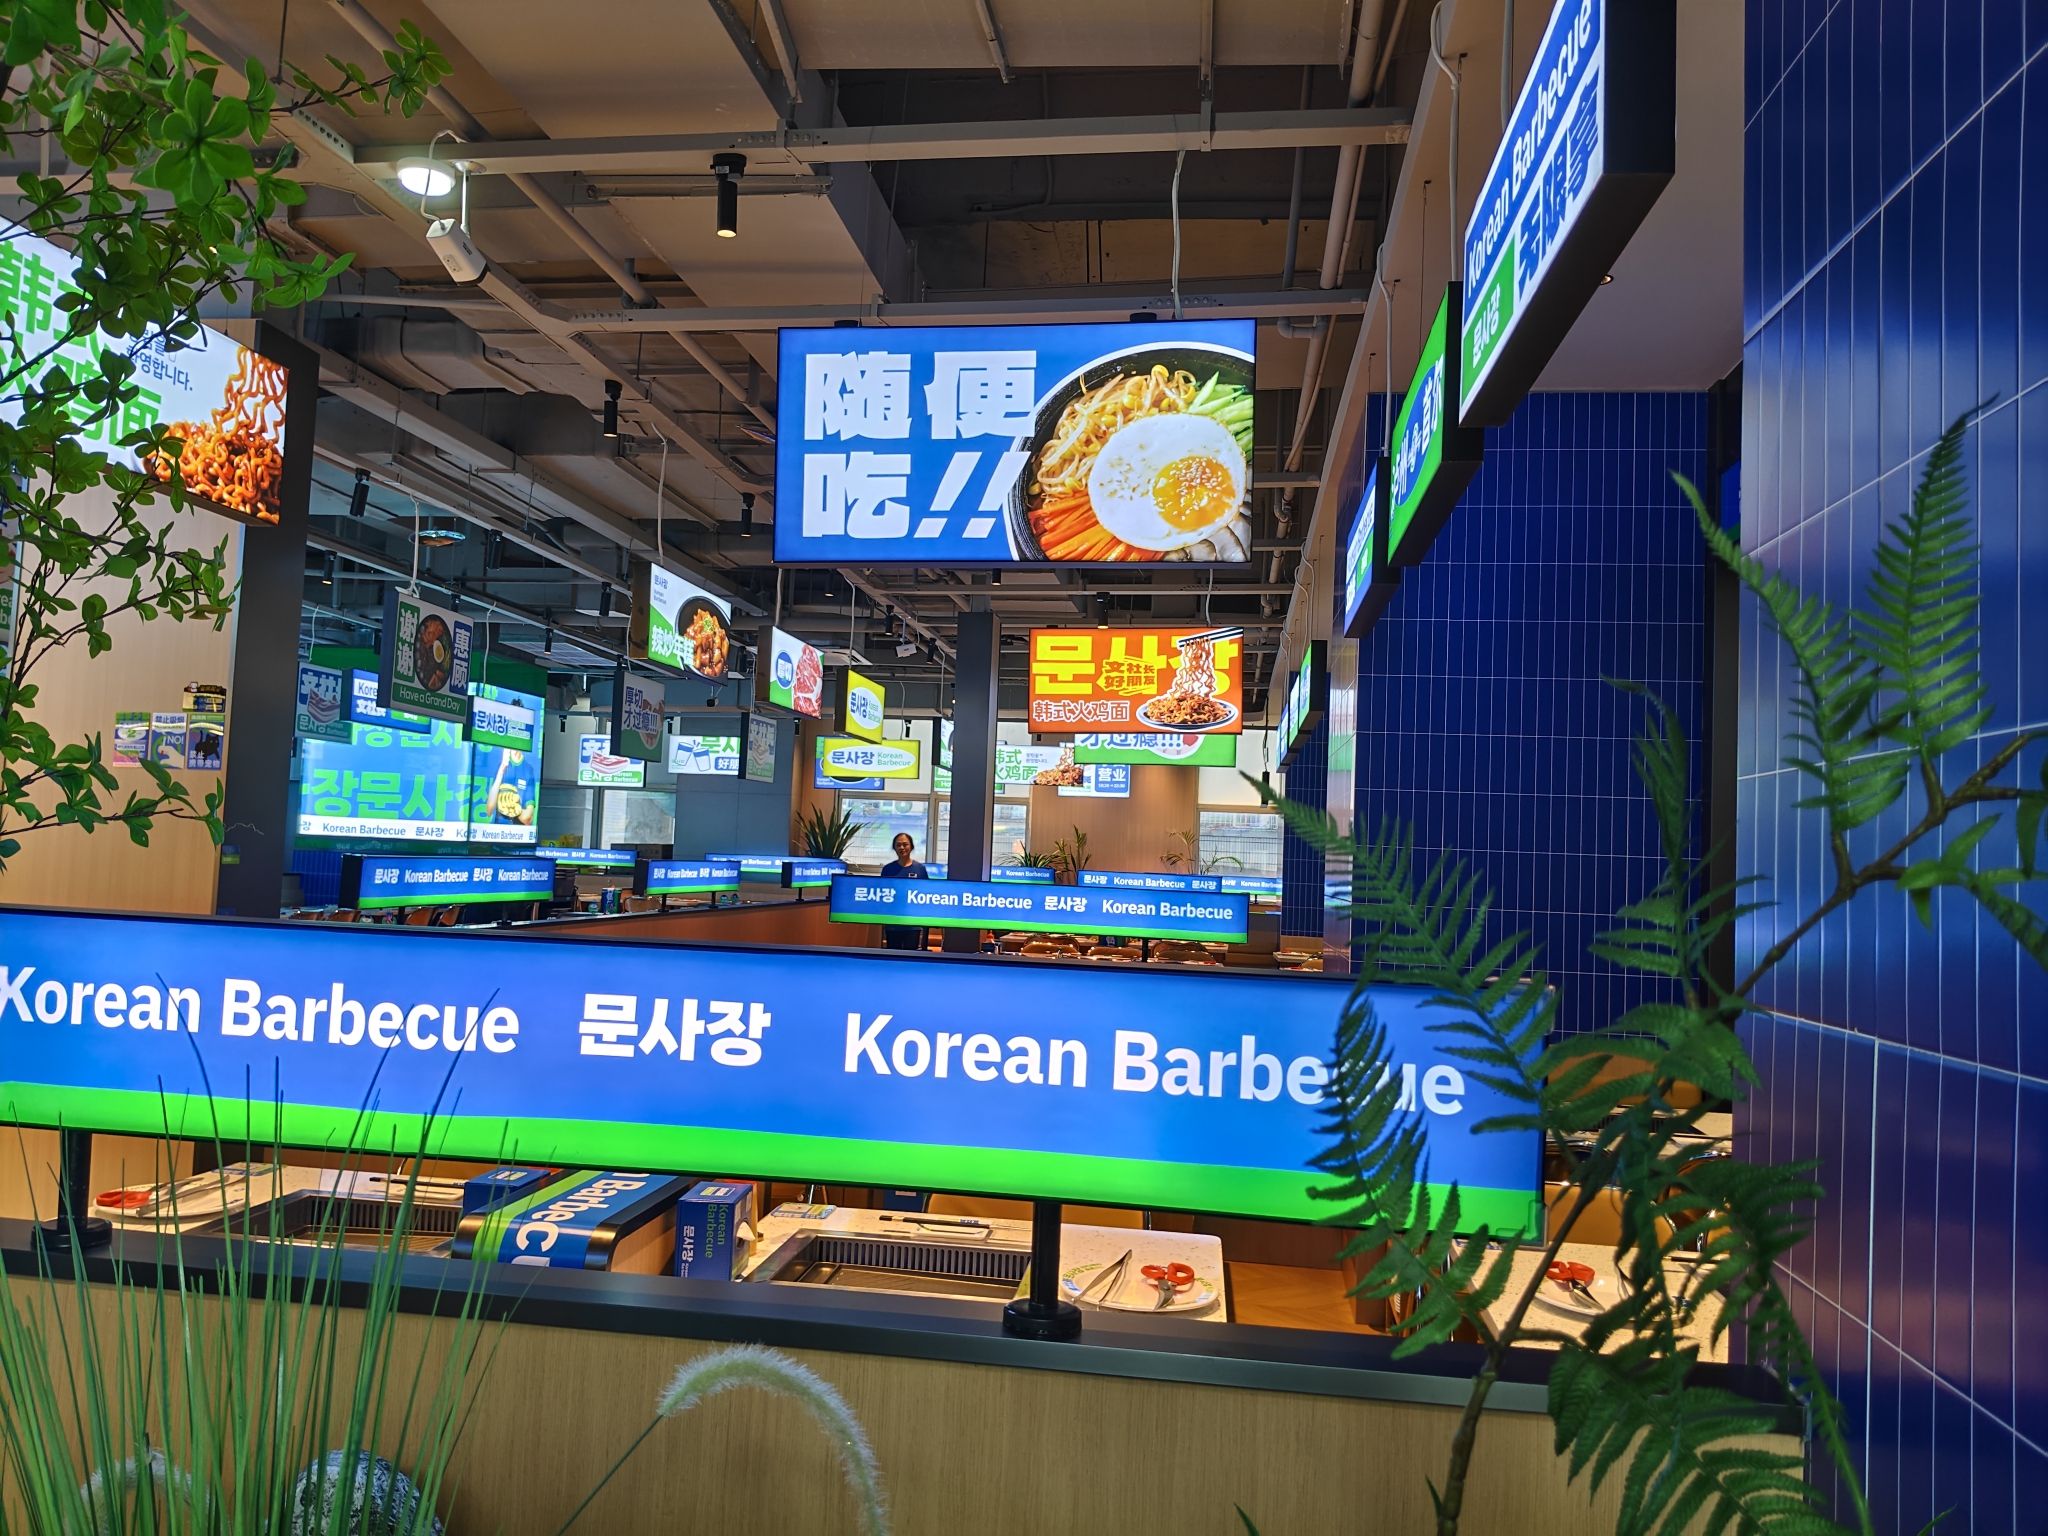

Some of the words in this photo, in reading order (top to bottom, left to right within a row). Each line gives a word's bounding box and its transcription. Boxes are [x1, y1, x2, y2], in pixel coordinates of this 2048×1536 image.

[1468, 177, 1510, 298] Korean
[1512, 0, 1592, 201] Barbecue
[1518, 65, 1598, 302] 无限享
[1473, 282, 1501, 368] 문사장
[803, 350, 1037, 441] 随便
[802, 451, 1031, 539] 吃!!
[397, 608, 418, 677] 谢谢
[451, 627, 471, 690] 惠顾
[1104, 660, 1157, 675] 文社长
[358, 681, 378, 697] Kore
[1104, 675, 1156, 689] 好朋友
[399, 687, 419, 702] Have
[420, 694, 424, 702] a
[425, 693, 446, 707] Grand
[446, 697, 461, 712] Day
[850, 691, 868, 719] 문사장
[1032, 701, 1130, 722] 韩式火鸡面
[476, 710, 508, 734] 문사장
[716, 759, 740, 770] 好朋
[831, 750, 874, 766] 문사장
[1098, 767, 1126, 782] 营业
[322, 822, 357, 834] Korean
[359, 824, 407, 837] Barbecue
[415, 826, 445, 838] 문사장
[482, 828, 500, 840] Korean
[374, 868, 400, 884] 문사장
[404, 869, 433, 883] Korean
[433, 869, 469, 883] Barbecue
[473, 867, 494, 882] 문사장
[498, 869, 521, 882] Korean
[520, 869, 549, 882] Barbecue
[1083, 874, 1108, 885] 문사장
[1113, 876, 1145, 887] Korean
[1146, 877, 1186, 889] Barbecue
[1192, 879, 1217, 890] 문사장
[854, 887, 896, 904] 문사장
[907, 889, 959, 906] Korean
[962, 891, 1033, 910] Barbecue
[1043, 895, 1088, 913] 문사장
[1102, 898, 1156, 916] Korean
[1159, 901, 1234, 920] Barbecue
[0, 965, 200, 1033] Korean
[221, 978, 520, 1053] Barbecue
[578, 993, 772, 1067] 문사장
[843, 1012, 1088, 1088] Korean
[510, 1178, 648, 1267] Barbec
[704, 1203, 717, 1258] Barbecue
[717, 1203, 729, 1245] Korean
[682, 1225, 695, 1262] 문사장
